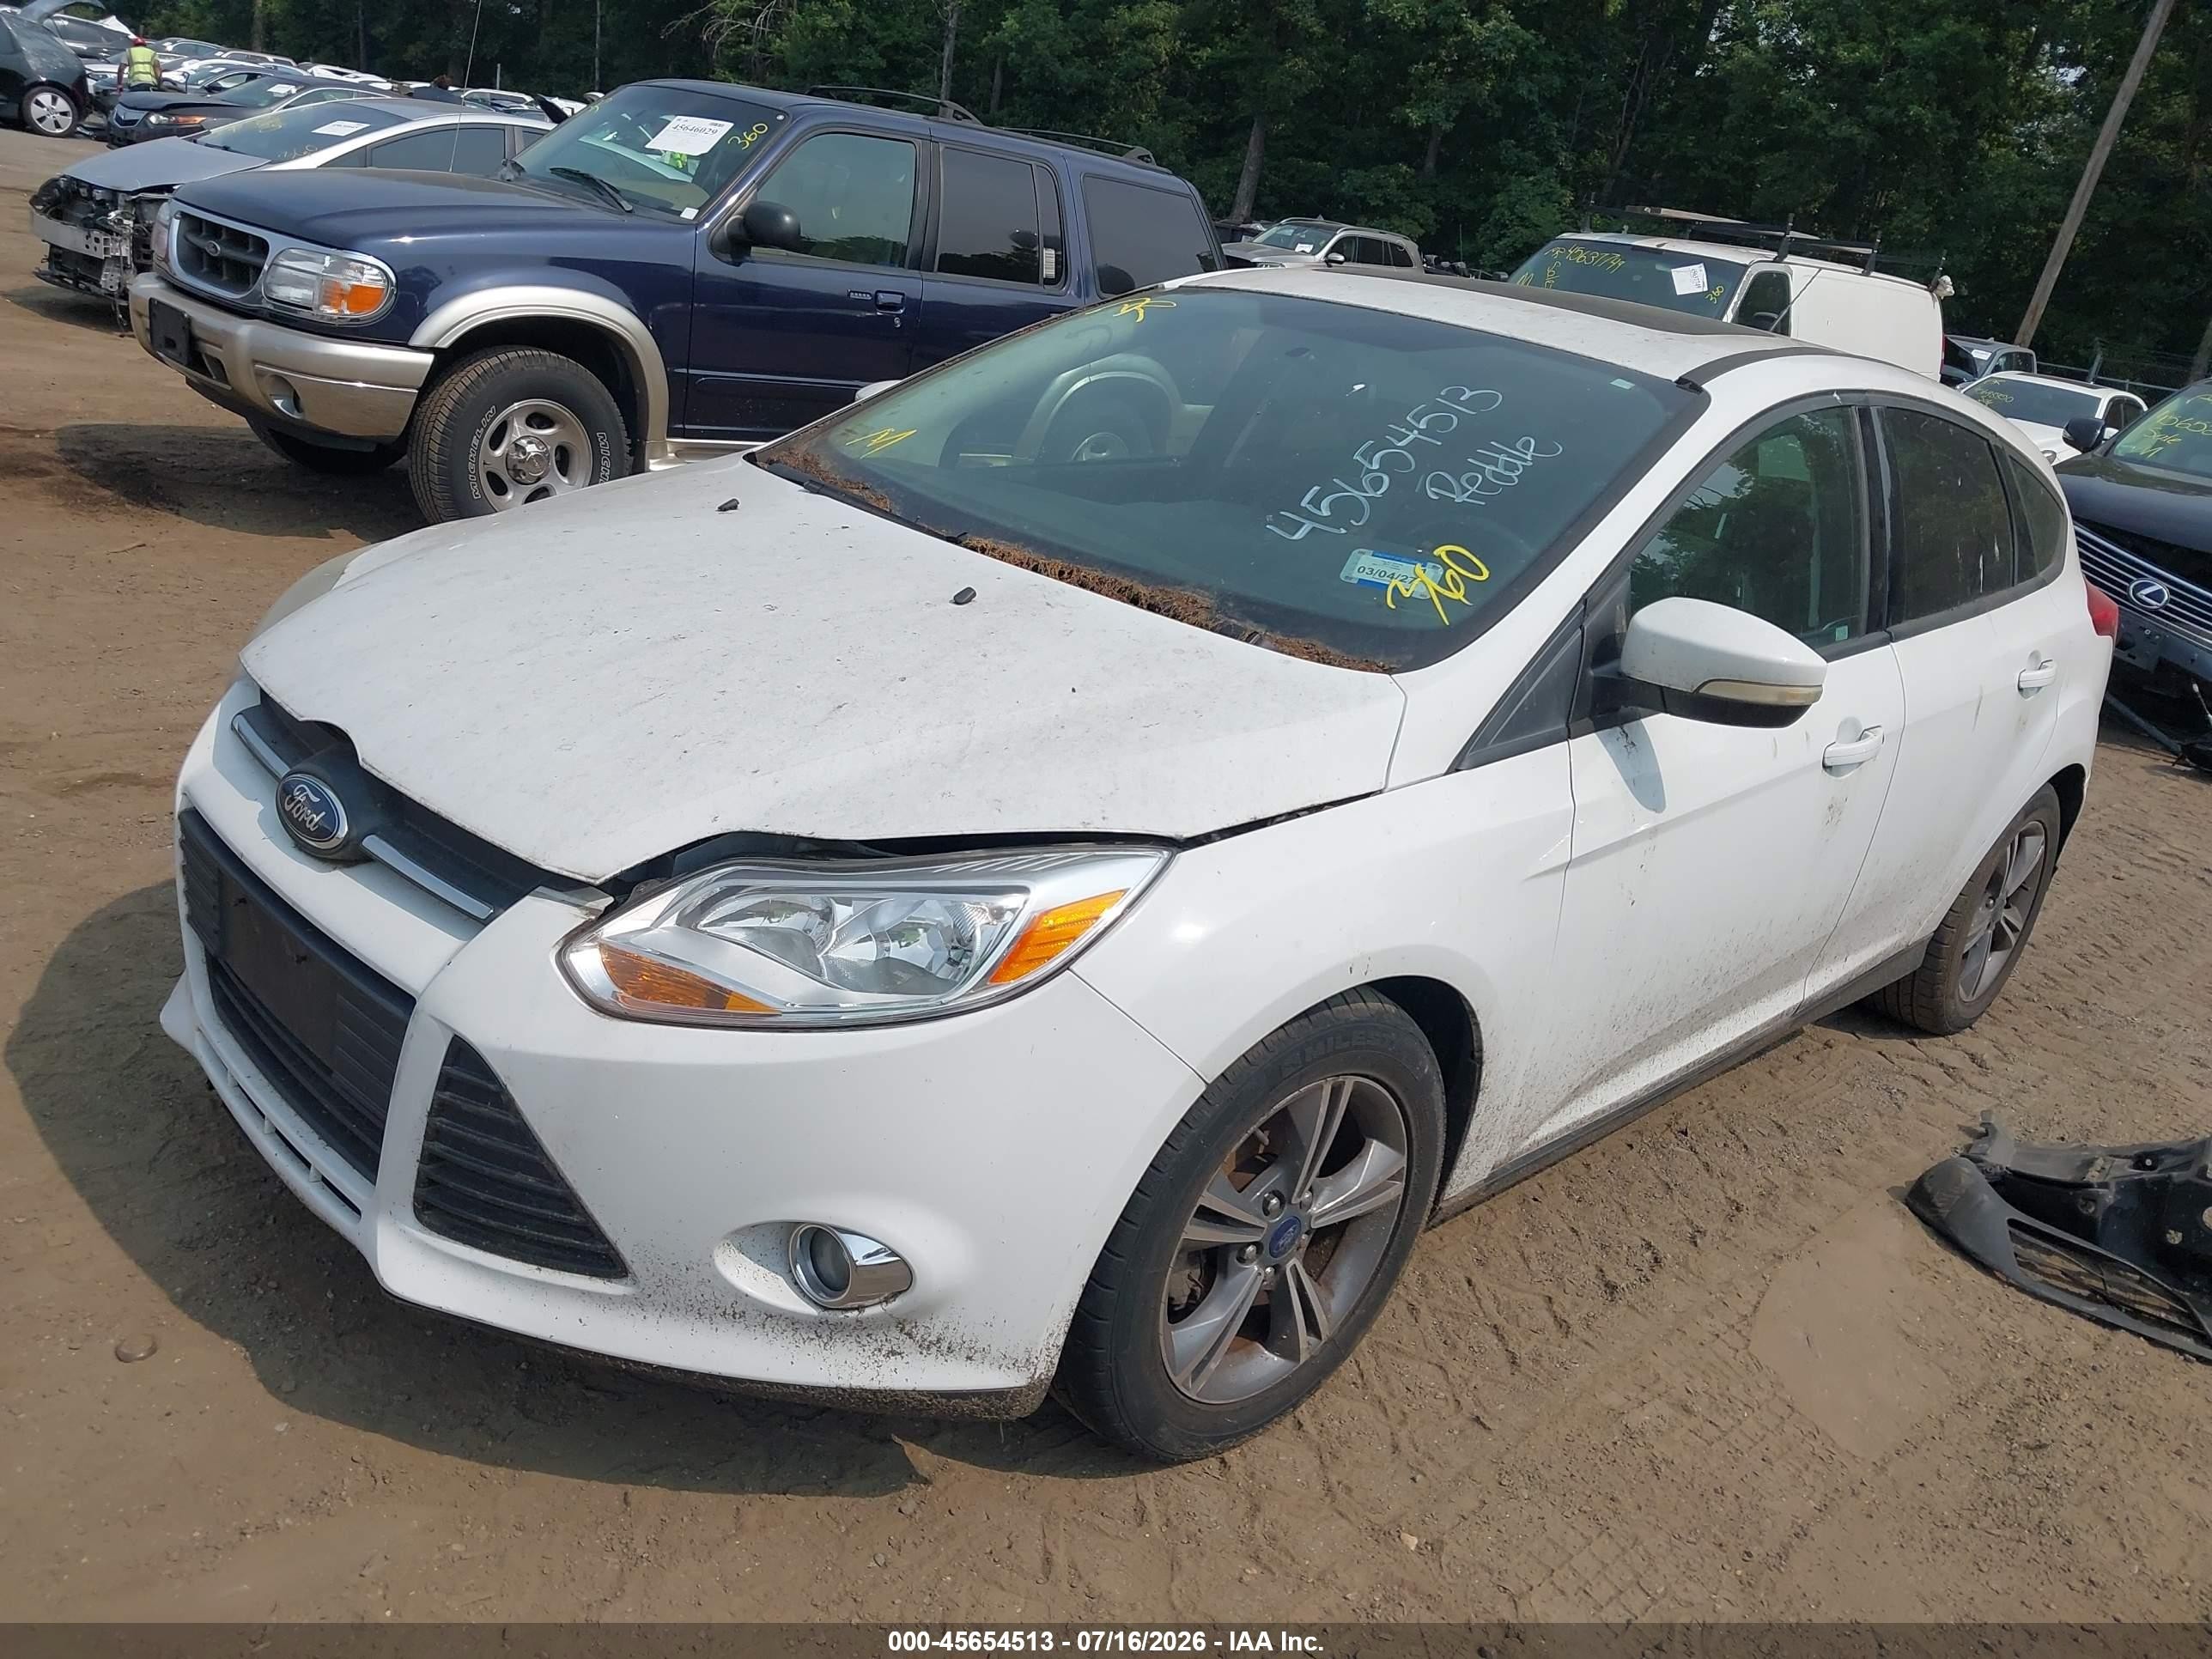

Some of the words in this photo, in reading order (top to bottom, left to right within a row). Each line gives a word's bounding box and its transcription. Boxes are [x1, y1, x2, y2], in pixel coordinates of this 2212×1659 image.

[727, 123, 769, 149] 360
[468, 404, 497, 500] MICHELIN
[1266, 386, 1504, 540] 45654513
[284, 783, 326, 832] Ford
